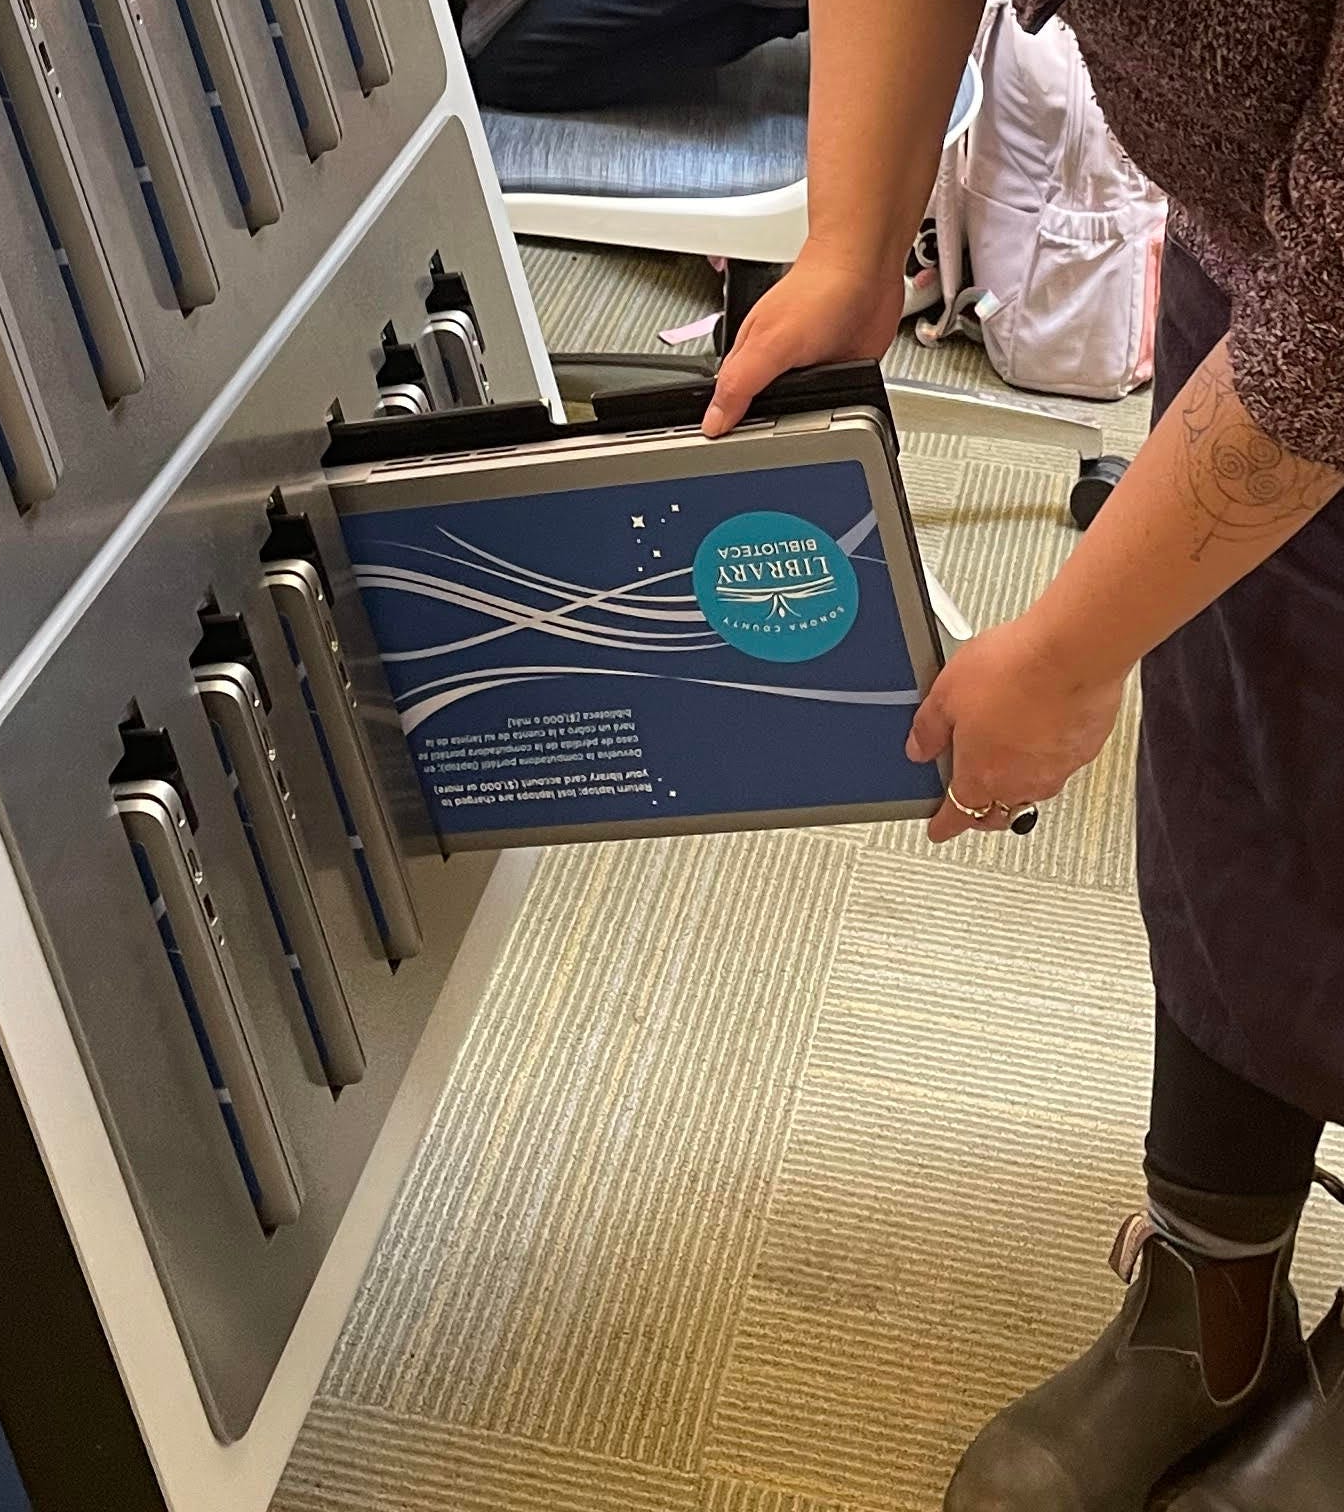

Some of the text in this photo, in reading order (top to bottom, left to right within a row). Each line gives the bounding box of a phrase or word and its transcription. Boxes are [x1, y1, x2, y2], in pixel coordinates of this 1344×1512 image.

[717, 538, 817, 559] BIBLIOTECA
[717, 556, 830, 585] LIBRARY
[722, 605, 845, 633] SONOMA COUNTY
[583, 709, 632, 720] biblioteca
[548, 728, 557, 737] la
[566, 725, 596, 735] cobro
[598, 724, 612, 732] un
[450, 735, 483, 745] tarjeta
[484, 734, 496, 742] su
[512, 730, 546, 740] cuenta
[616, 735, 639, 744] caso
[425, 739, 434, 747] la
[436, 737, 449, 746] de
[545, 741, 558, 749] de
[601, 736, 614, 745] de
[468, 743, 533, 756] computadora
[535, 743, 544, 751] la
[418, 753, 428, 761] se
[586, 753, 595, 761] la
[597, 748, 642, 759] Devuelva
[519, 753, 584, 765] computadora
[423, 765, 436, 773] en
[625, 768, 649, 780] your
[564, 774, 587, 784] card
[589, 772, 623, 782] library
[521, 778, 562, 788] account
[617, 783, 652, 793] Return
[433, 785, 464, 796] more)
[517, 789, 556, 801] laptops
[558, 789, 577, 799] lost
[455, 795, 496, 806] charged
[499, 793, 514, 801] are
[441, 799, 453, 808] to
